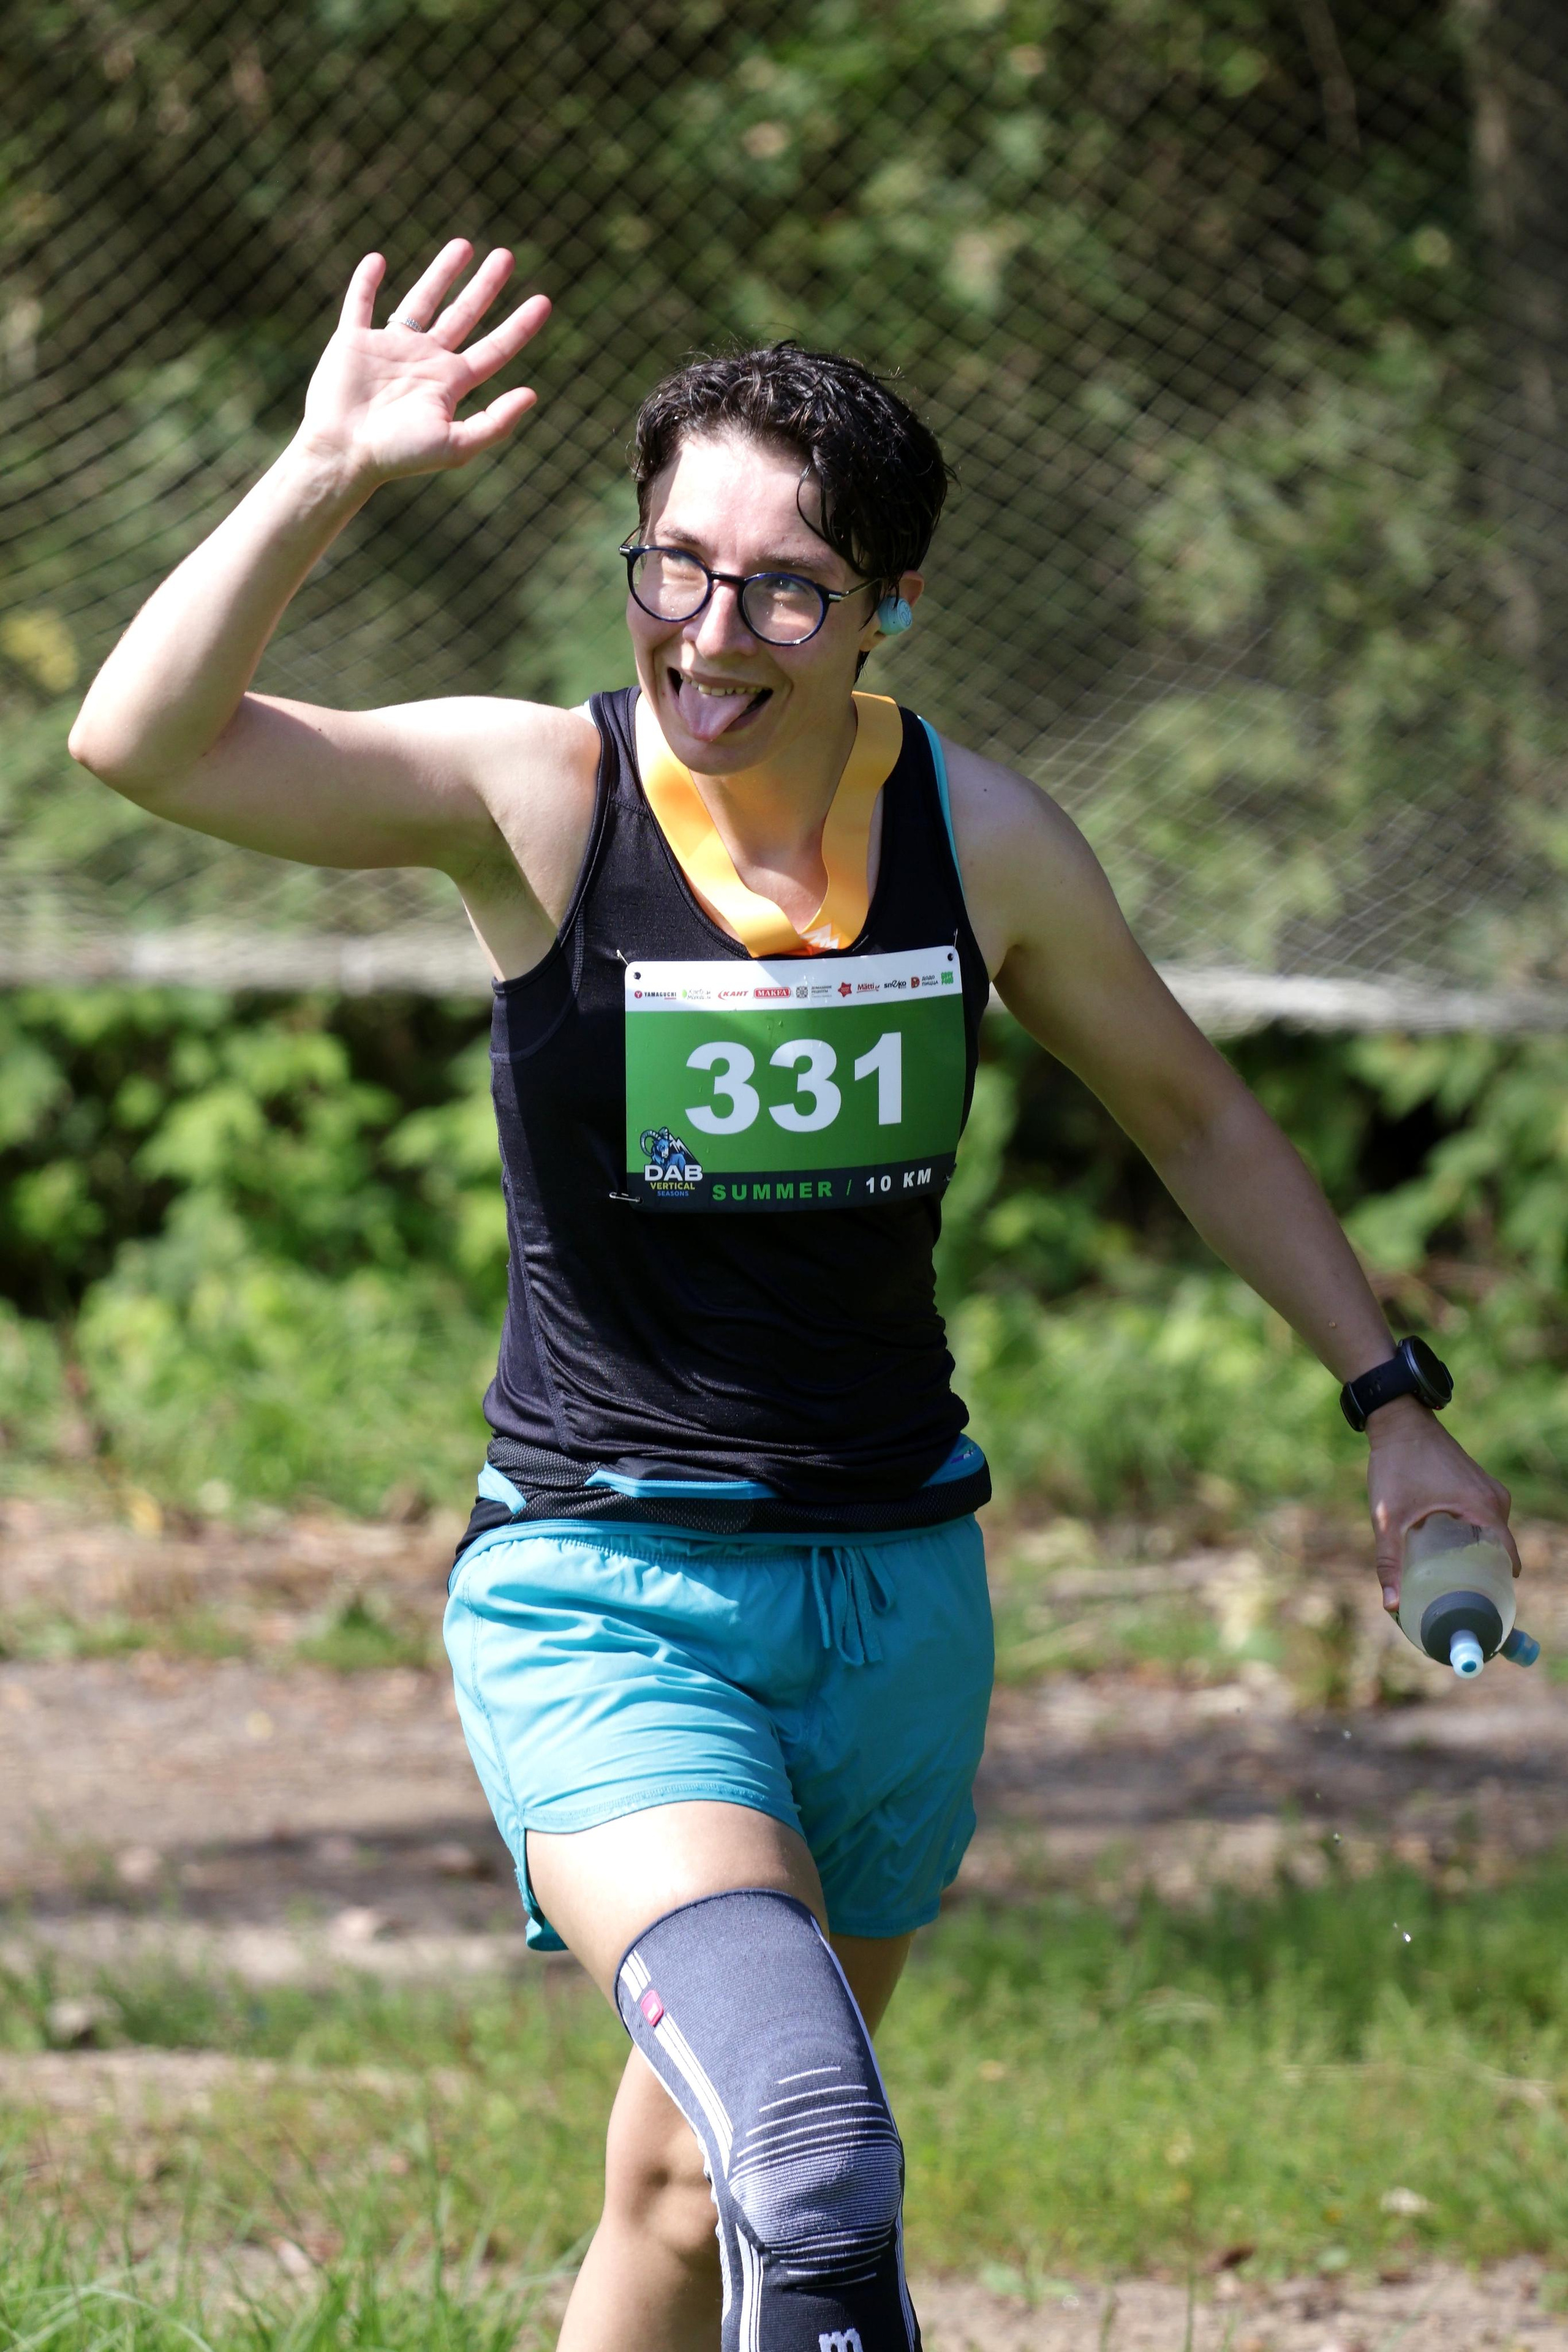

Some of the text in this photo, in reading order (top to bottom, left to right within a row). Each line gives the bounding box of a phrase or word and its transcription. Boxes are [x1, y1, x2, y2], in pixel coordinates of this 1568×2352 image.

[684, 1031, 902, 1135] 331
[644, 1164, 703, 1182] DAB
[712, 1181, 832, 1200] SUMMER
[865, 1174, 891, 1194] 10
[903, 1167, 932, 1188] KM
